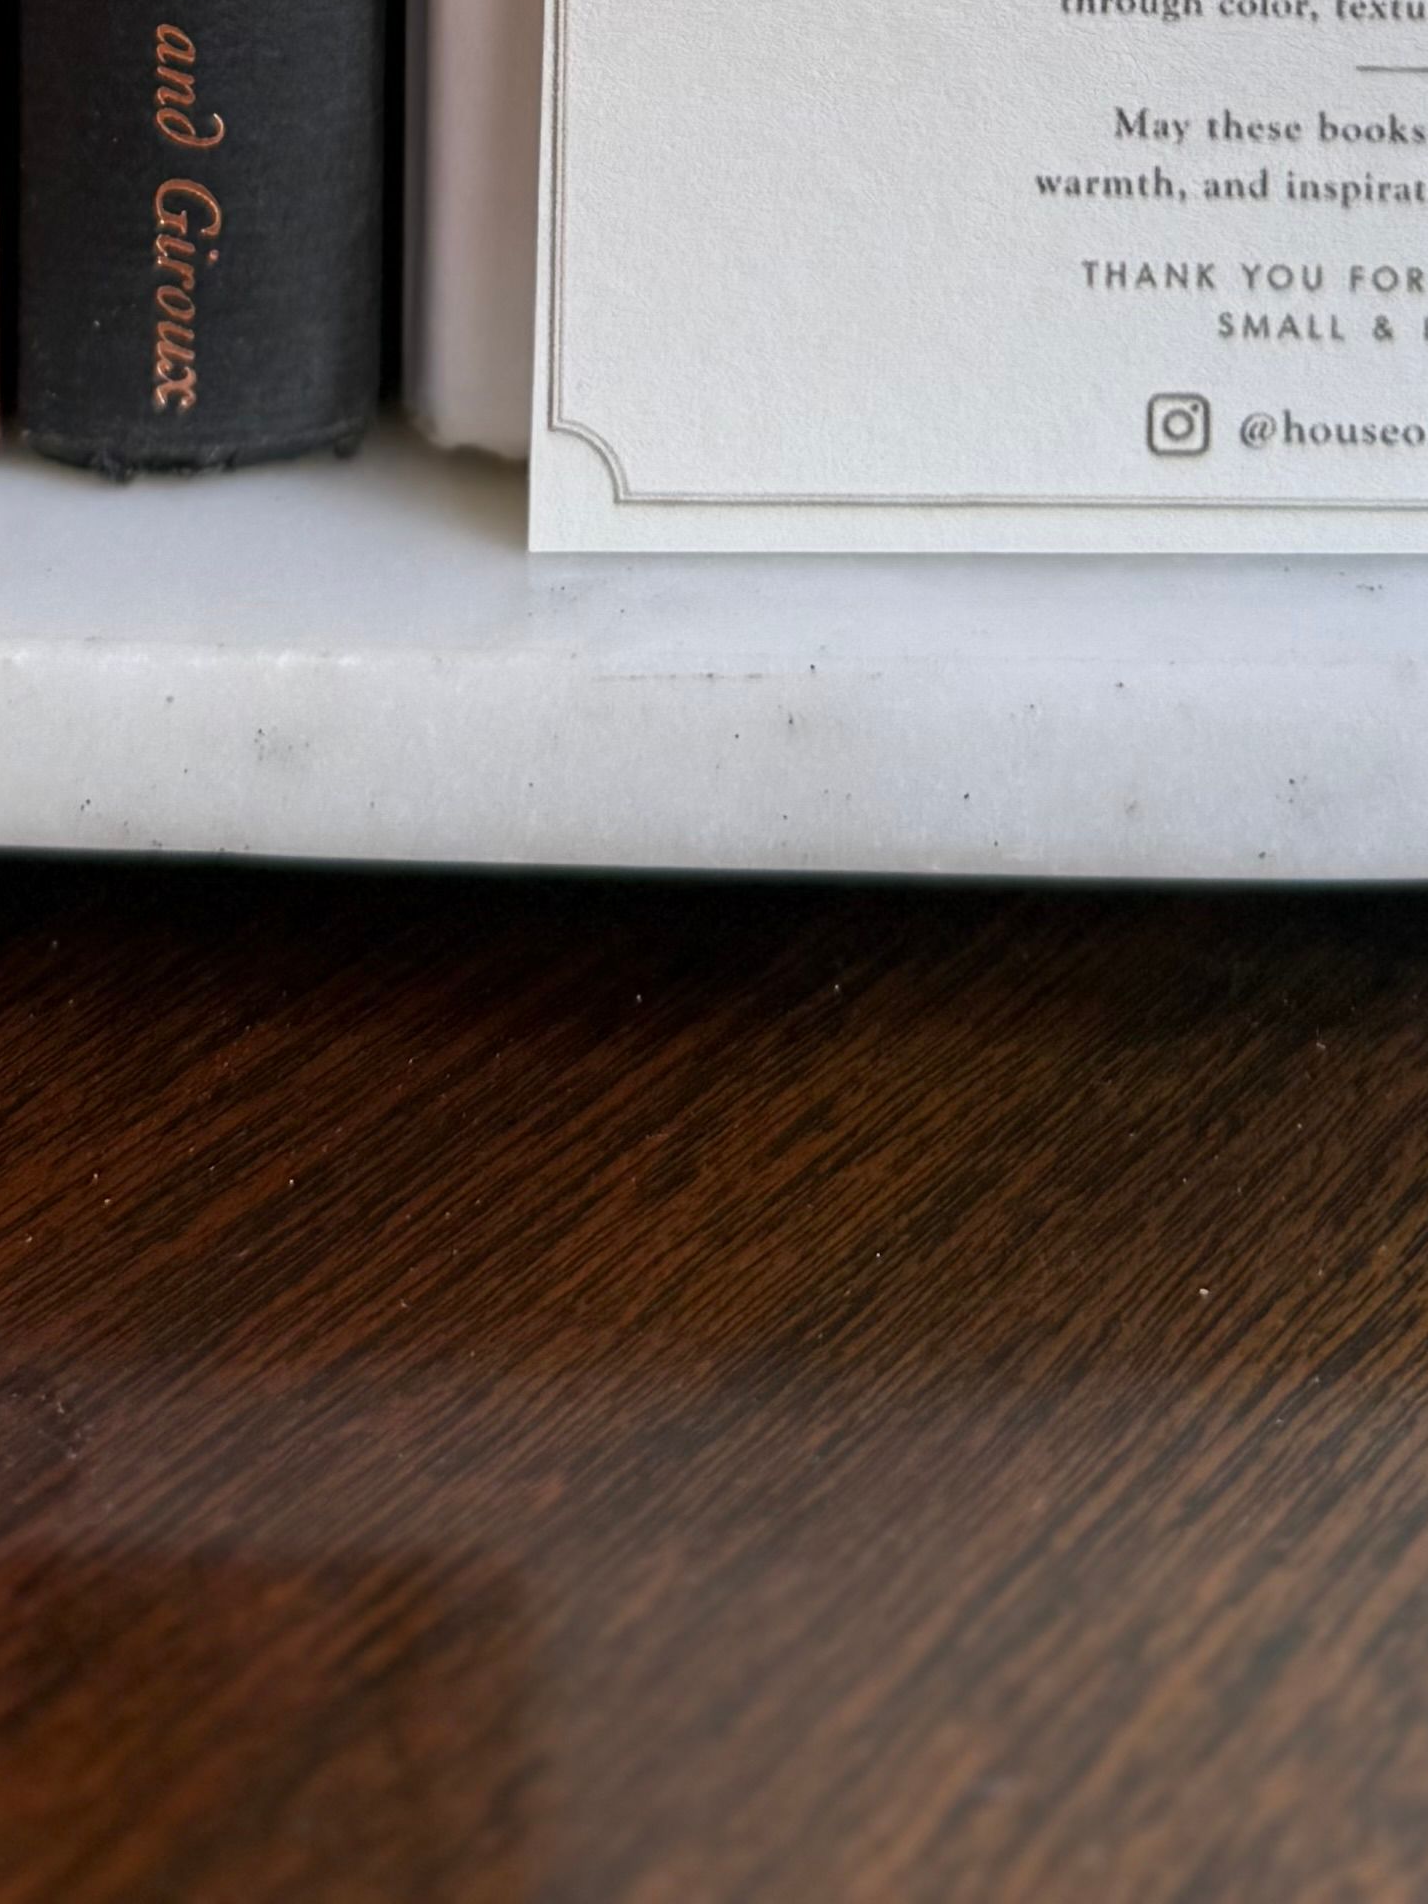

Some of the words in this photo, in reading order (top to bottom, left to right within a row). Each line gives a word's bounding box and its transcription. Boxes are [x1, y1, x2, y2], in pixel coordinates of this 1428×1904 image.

[154, 24, 226, 149] and
[1112, 104, 1192, 148] May
[1205, 106, 1304, 145] these
[1316, 108, 1428, 148] books
[1033, 163, 1189, 205] warmth,
[1201, 165, 1271, 203] and
[153, 179, 222, 411] Giroux
[1079, 258, 1218, 293] THANK
[1239, 261, 1326, 296] YOU
[1347, 263, 1426, 297] FOR
[1216, 310, 1347, 344] SMALL
[1370, 313, 1396, 345] &
